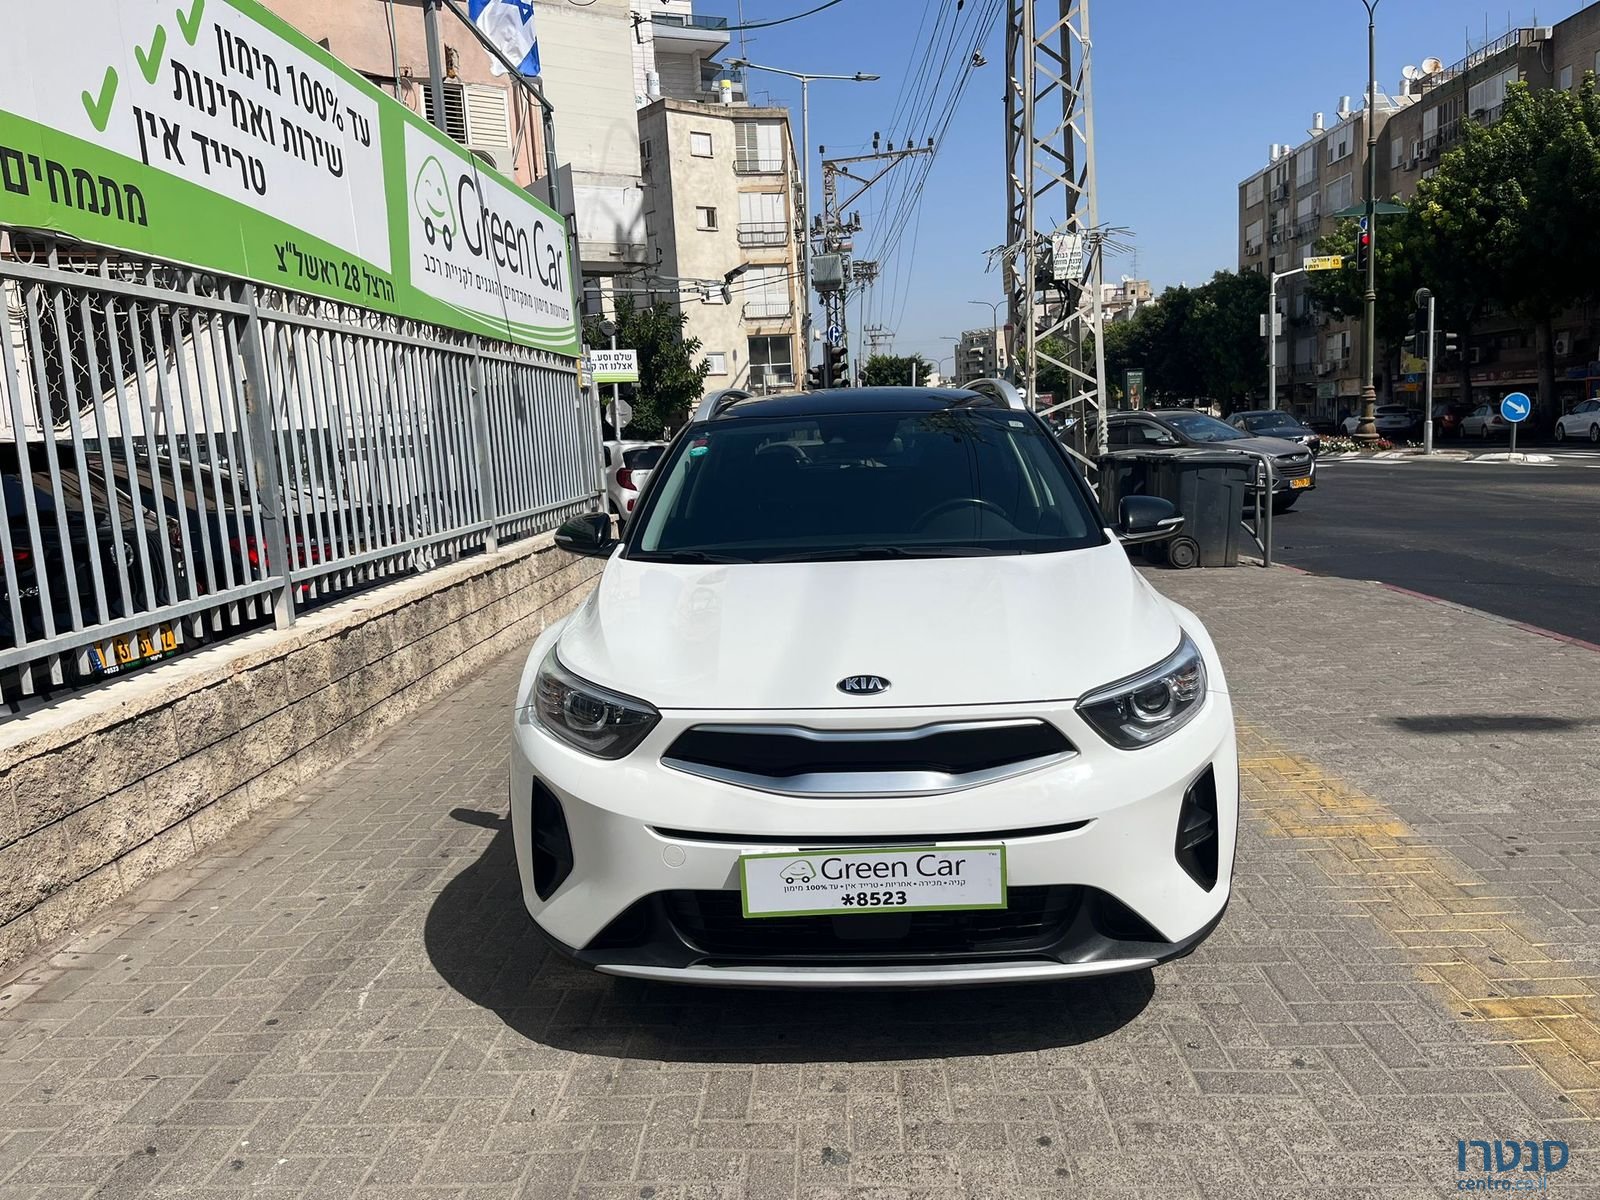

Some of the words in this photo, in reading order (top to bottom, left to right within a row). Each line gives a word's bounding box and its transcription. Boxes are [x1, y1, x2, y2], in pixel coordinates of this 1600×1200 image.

[214, 22, 281, 97] מימון
[170, 58, 276, 147] ואמינות
[286, 65, 344, 132] 100%
[133, 105, 186, 166] אין
[346, 106, 371, 147] עד
[191, 130, 267, 196] טרייד
[280, 116, 344, 178] שירות
[0, 146, 148, 227] מתמחים
[458, 174, 532, 279] Green
[533, 220, 563, 293] Car
[342, 261, 361, 292] 28
[424, 253, 443, 276] רכב
[445, 262, 472, 290] לקניית
[362, 266, 395, 303] הרצל
[611, 362, 633, 370] אצלנו
[614, 353, 632, 361] שלם
[845, 677, 883, 690] KIA
[821, 857, 908, 880] Green
[916, 854, 966, 877] Car
[948, 879, 966, 887] קניה
[784, 885, 804, 893] מימון
